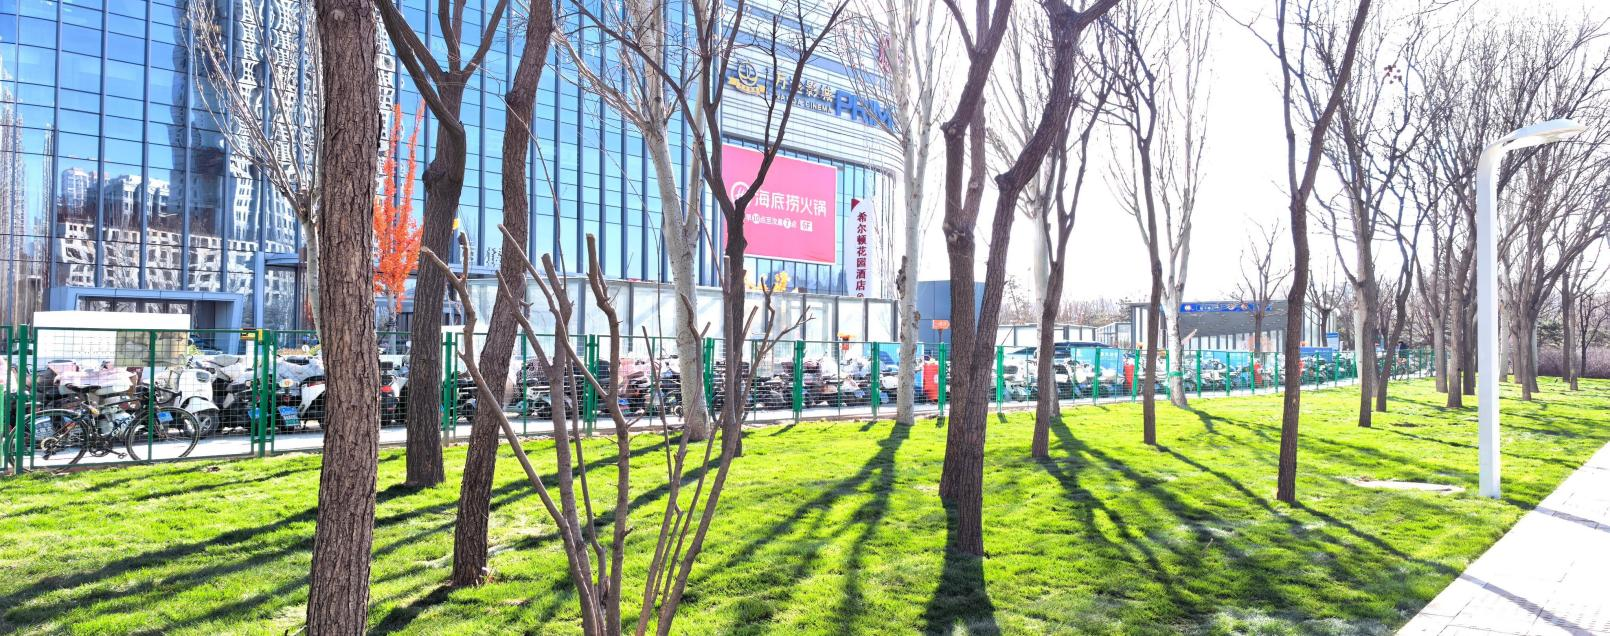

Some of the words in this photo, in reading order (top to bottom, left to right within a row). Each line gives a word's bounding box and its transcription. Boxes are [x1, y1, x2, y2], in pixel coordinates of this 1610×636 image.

[805, 100, 833, 114] CINEMA
[755, 190, 827, 217] 海底捞火锅
[856, 211, 868, 291] 希尔顿花园酒店
